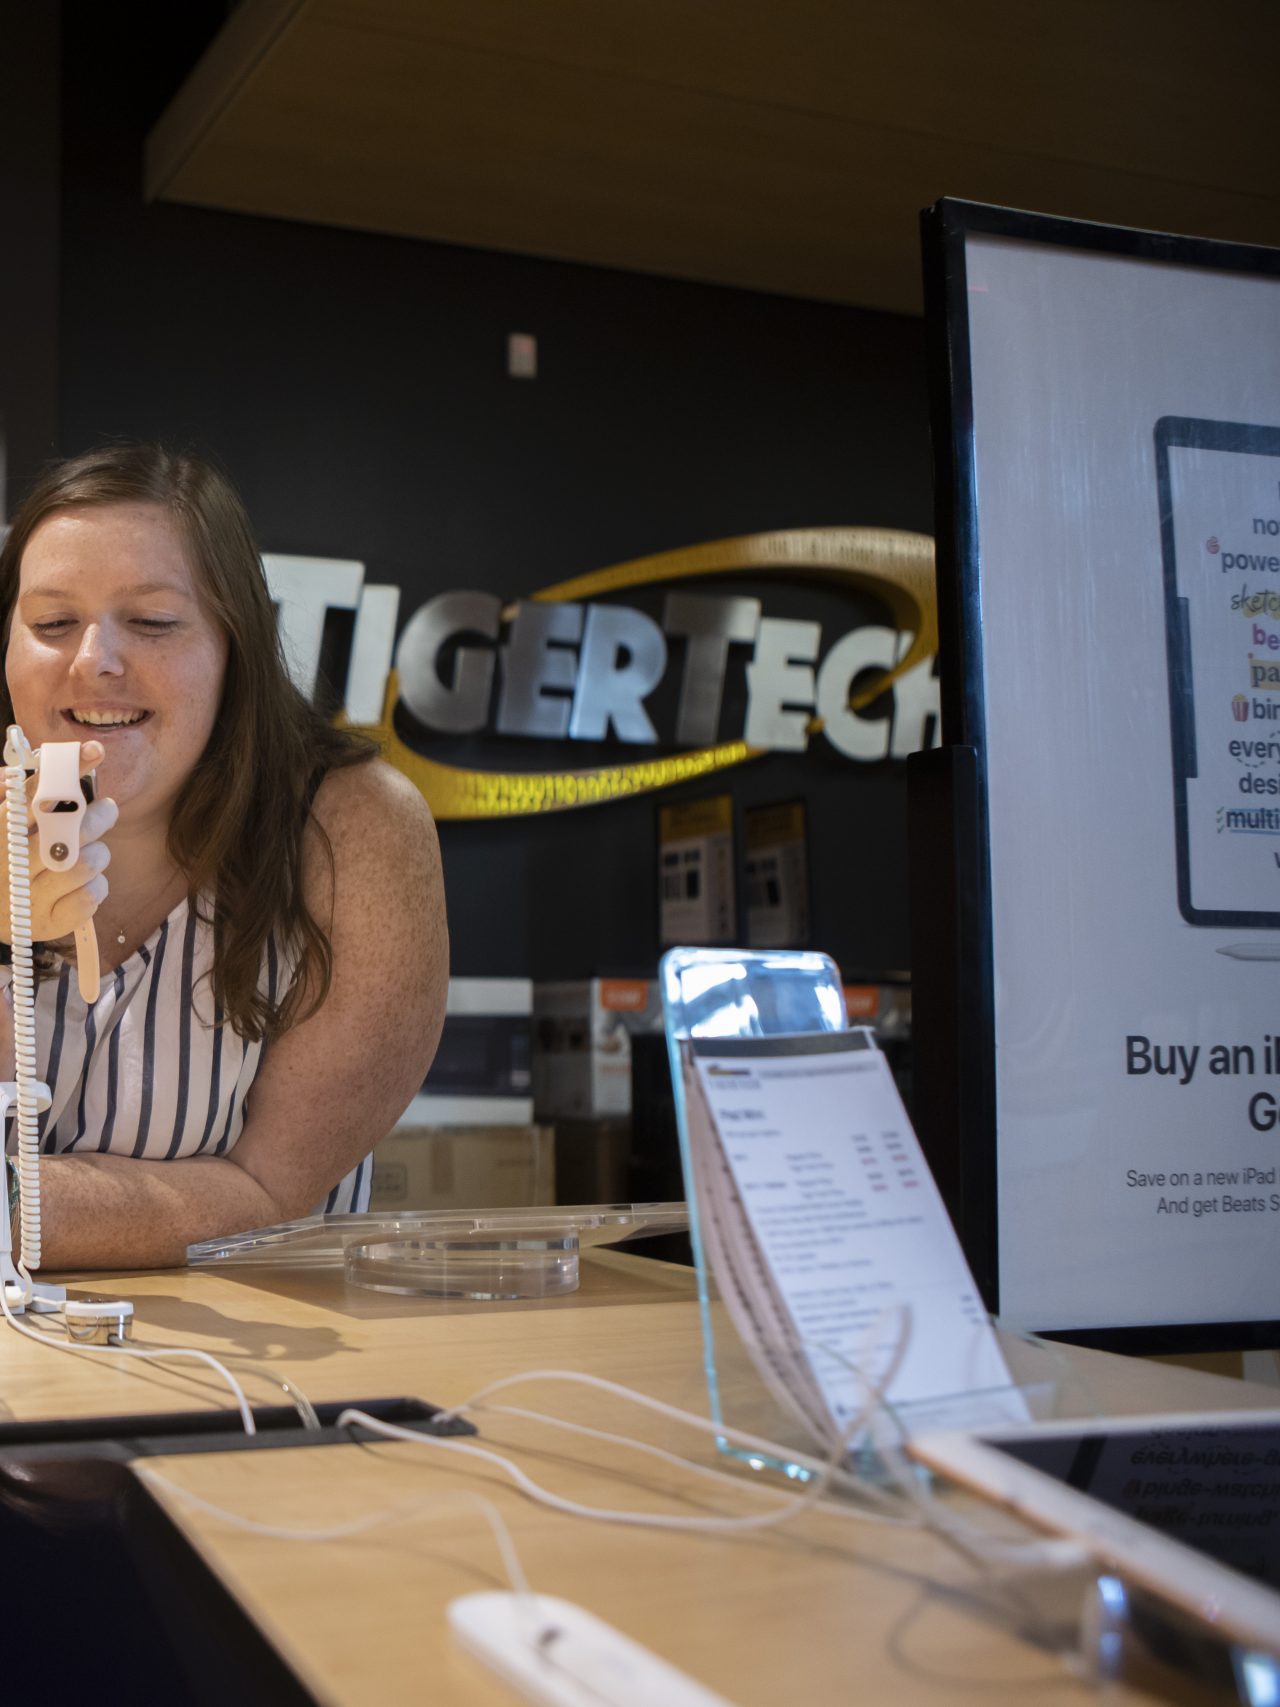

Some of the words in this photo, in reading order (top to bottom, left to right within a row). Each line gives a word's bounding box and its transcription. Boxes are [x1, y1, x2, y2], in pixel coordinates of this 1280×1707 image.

[1253, 517, 1280, 537] no
[1126, 1035, 1200, 1085] Buy
[1209, 1044, 1255, 1075] an
[1264, 1034, 1280, 1075] i
[1248, 1091, 1280, 1132] G
[1126, 1169, 1166, 1187] Save
[1169, 1172, 1189, 1186] on
[1193, 1172, 1203, 1186] a
[1206, 1171, 1239, 1185] new
[1243, 1166, 1275, 1185] iPad
[1157, 1196, 1189, 1214] And
[1192, 1197, 1218, 1217] get
[1222, 1195, 1266, 1212] Beats
